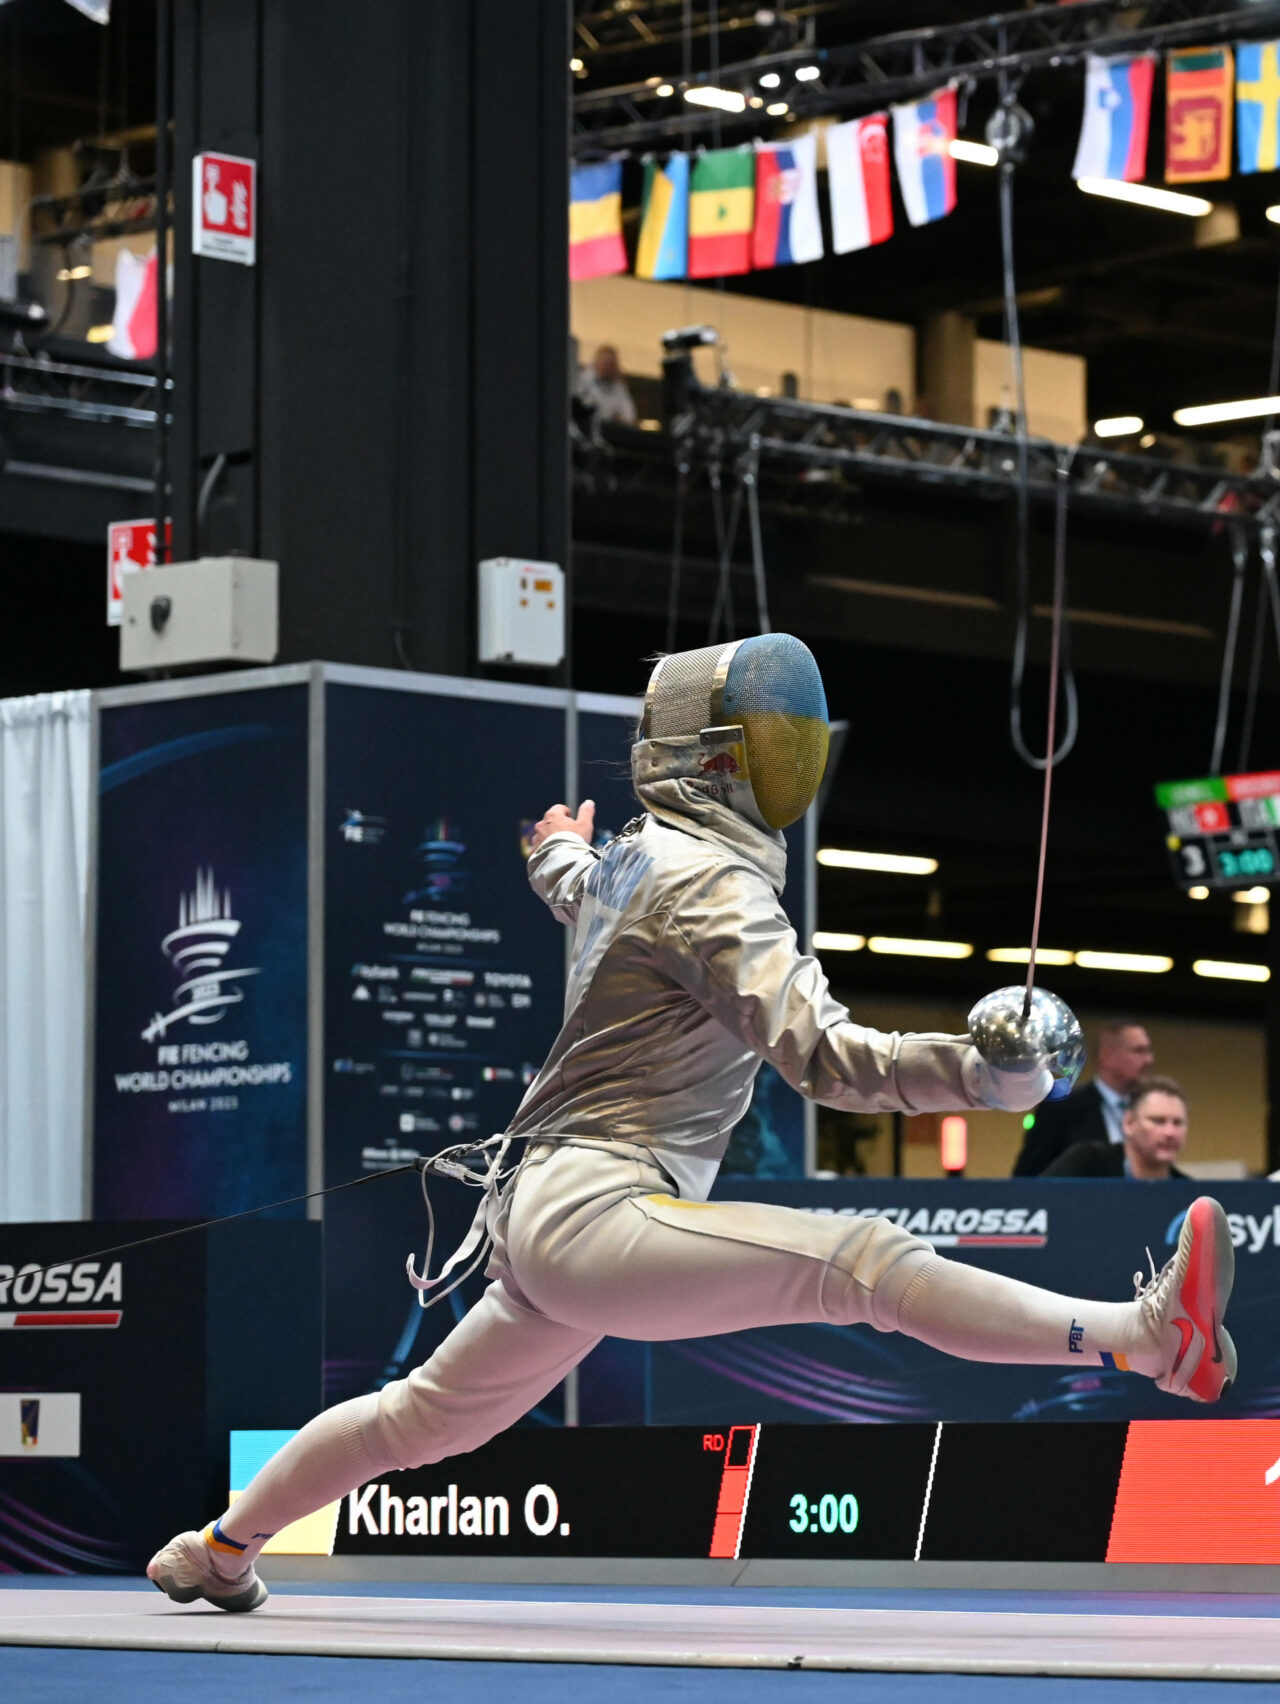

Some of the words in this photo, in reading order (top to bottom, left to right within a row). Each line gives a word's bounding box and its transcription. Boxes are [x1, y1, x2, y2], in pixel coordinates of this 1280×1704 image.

[181, 1040, 249, 1065] FENCING
[115, 1070, 169, 1093] WORLD
[170, 1062, 292, 1090] CHAMPIONSHIPS
[703, 1434, 725, 1451] RD
[348, 1484, 510, 1536] Kharlan
[524, 1484, 571, 1536] O.
[789, 1493, 860, 1533] 3:00
